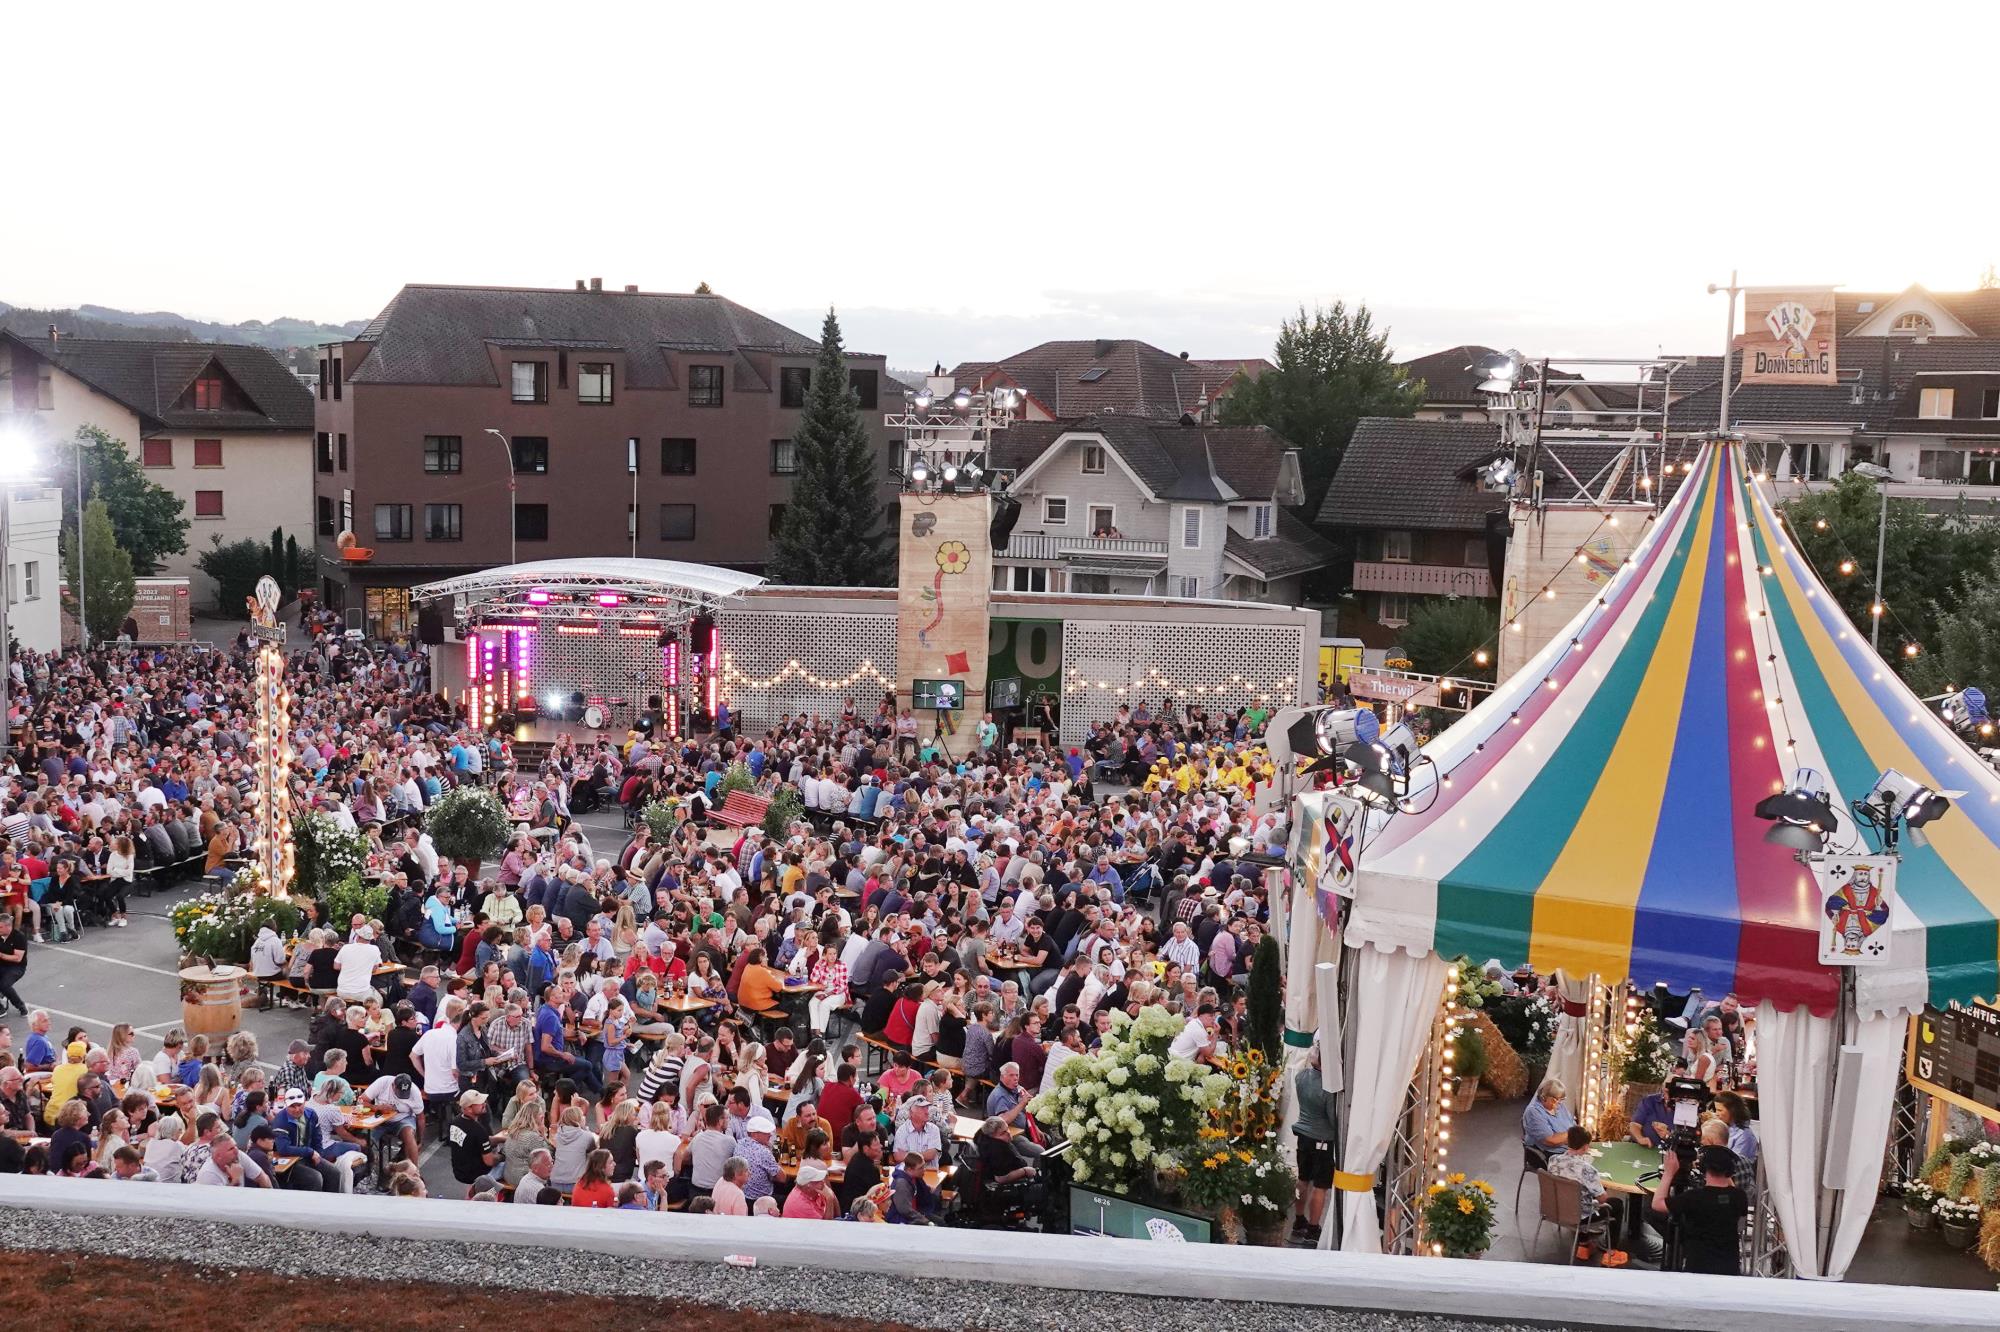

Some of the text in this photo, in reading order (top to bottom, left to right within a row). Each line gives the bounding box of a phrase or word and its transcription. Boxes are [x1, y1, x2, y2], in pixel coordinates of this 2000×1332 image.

[1771, 308, 1811, 333] JASS
[1371, 680, 1466, 708] Therwil 4
